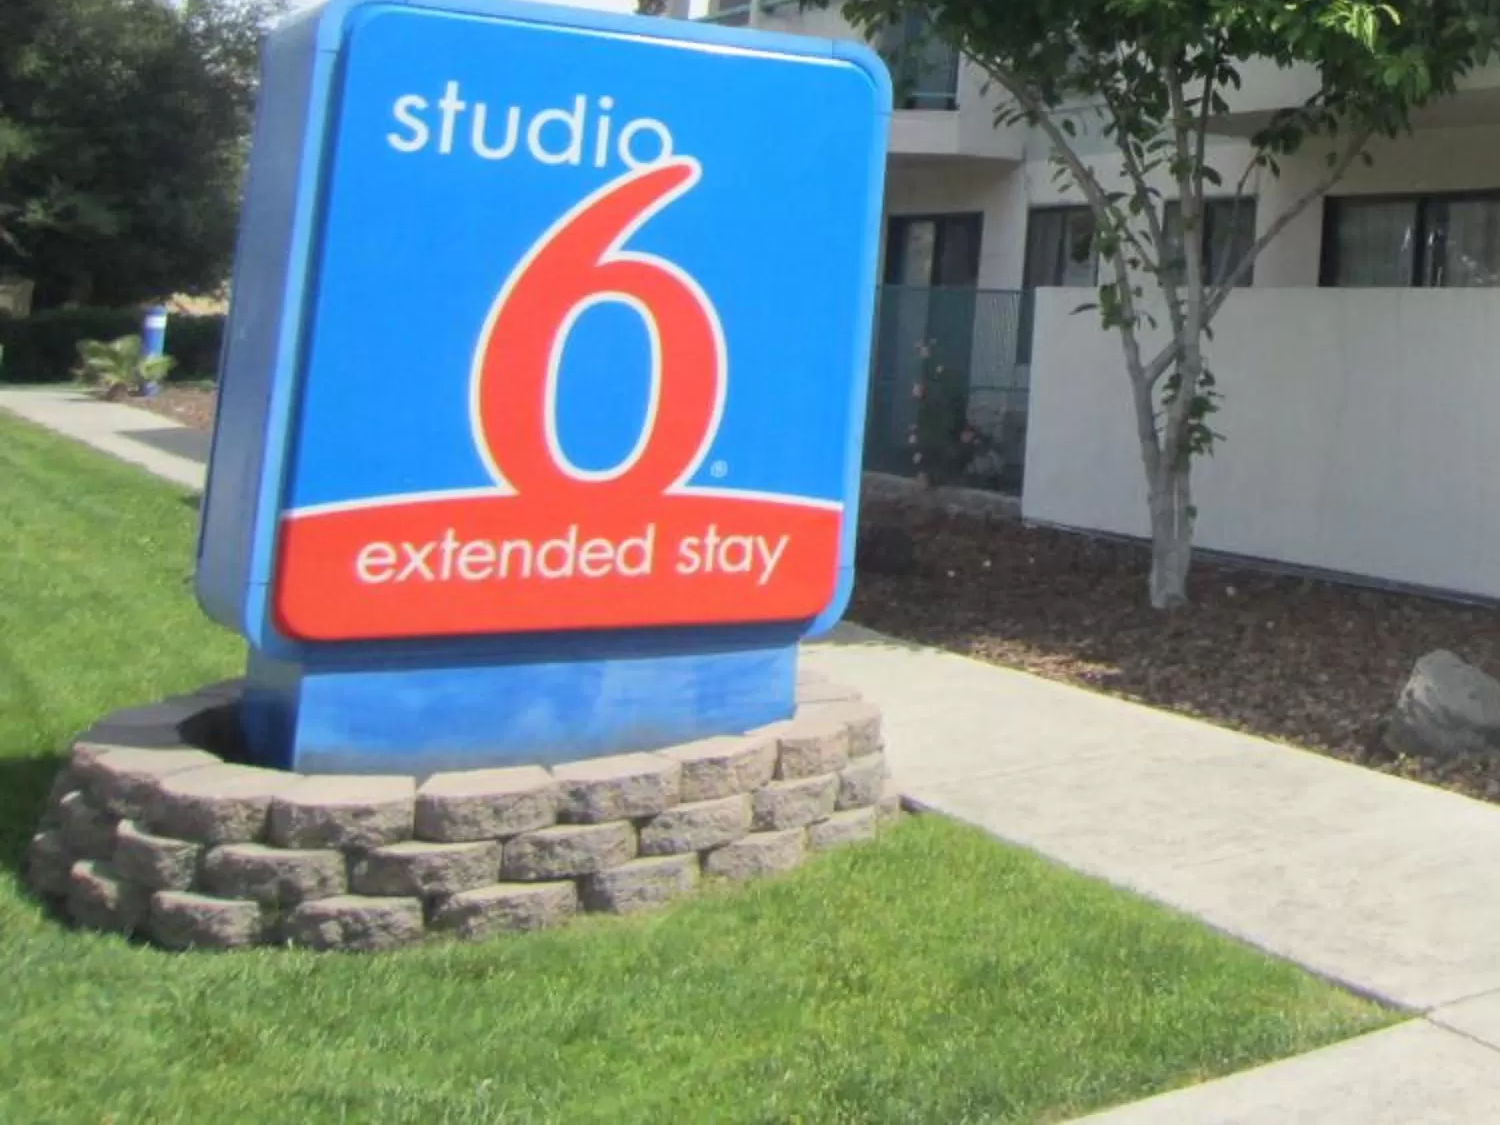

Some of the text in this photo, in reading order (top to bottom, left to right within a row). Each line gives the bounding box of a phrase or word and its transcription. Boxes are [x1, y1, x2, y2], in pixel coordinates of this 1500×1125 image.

[385, 80, 673, 169] studio
[469, 155, 728, 495] 6
[355, 523, 789, 585] extended stay
